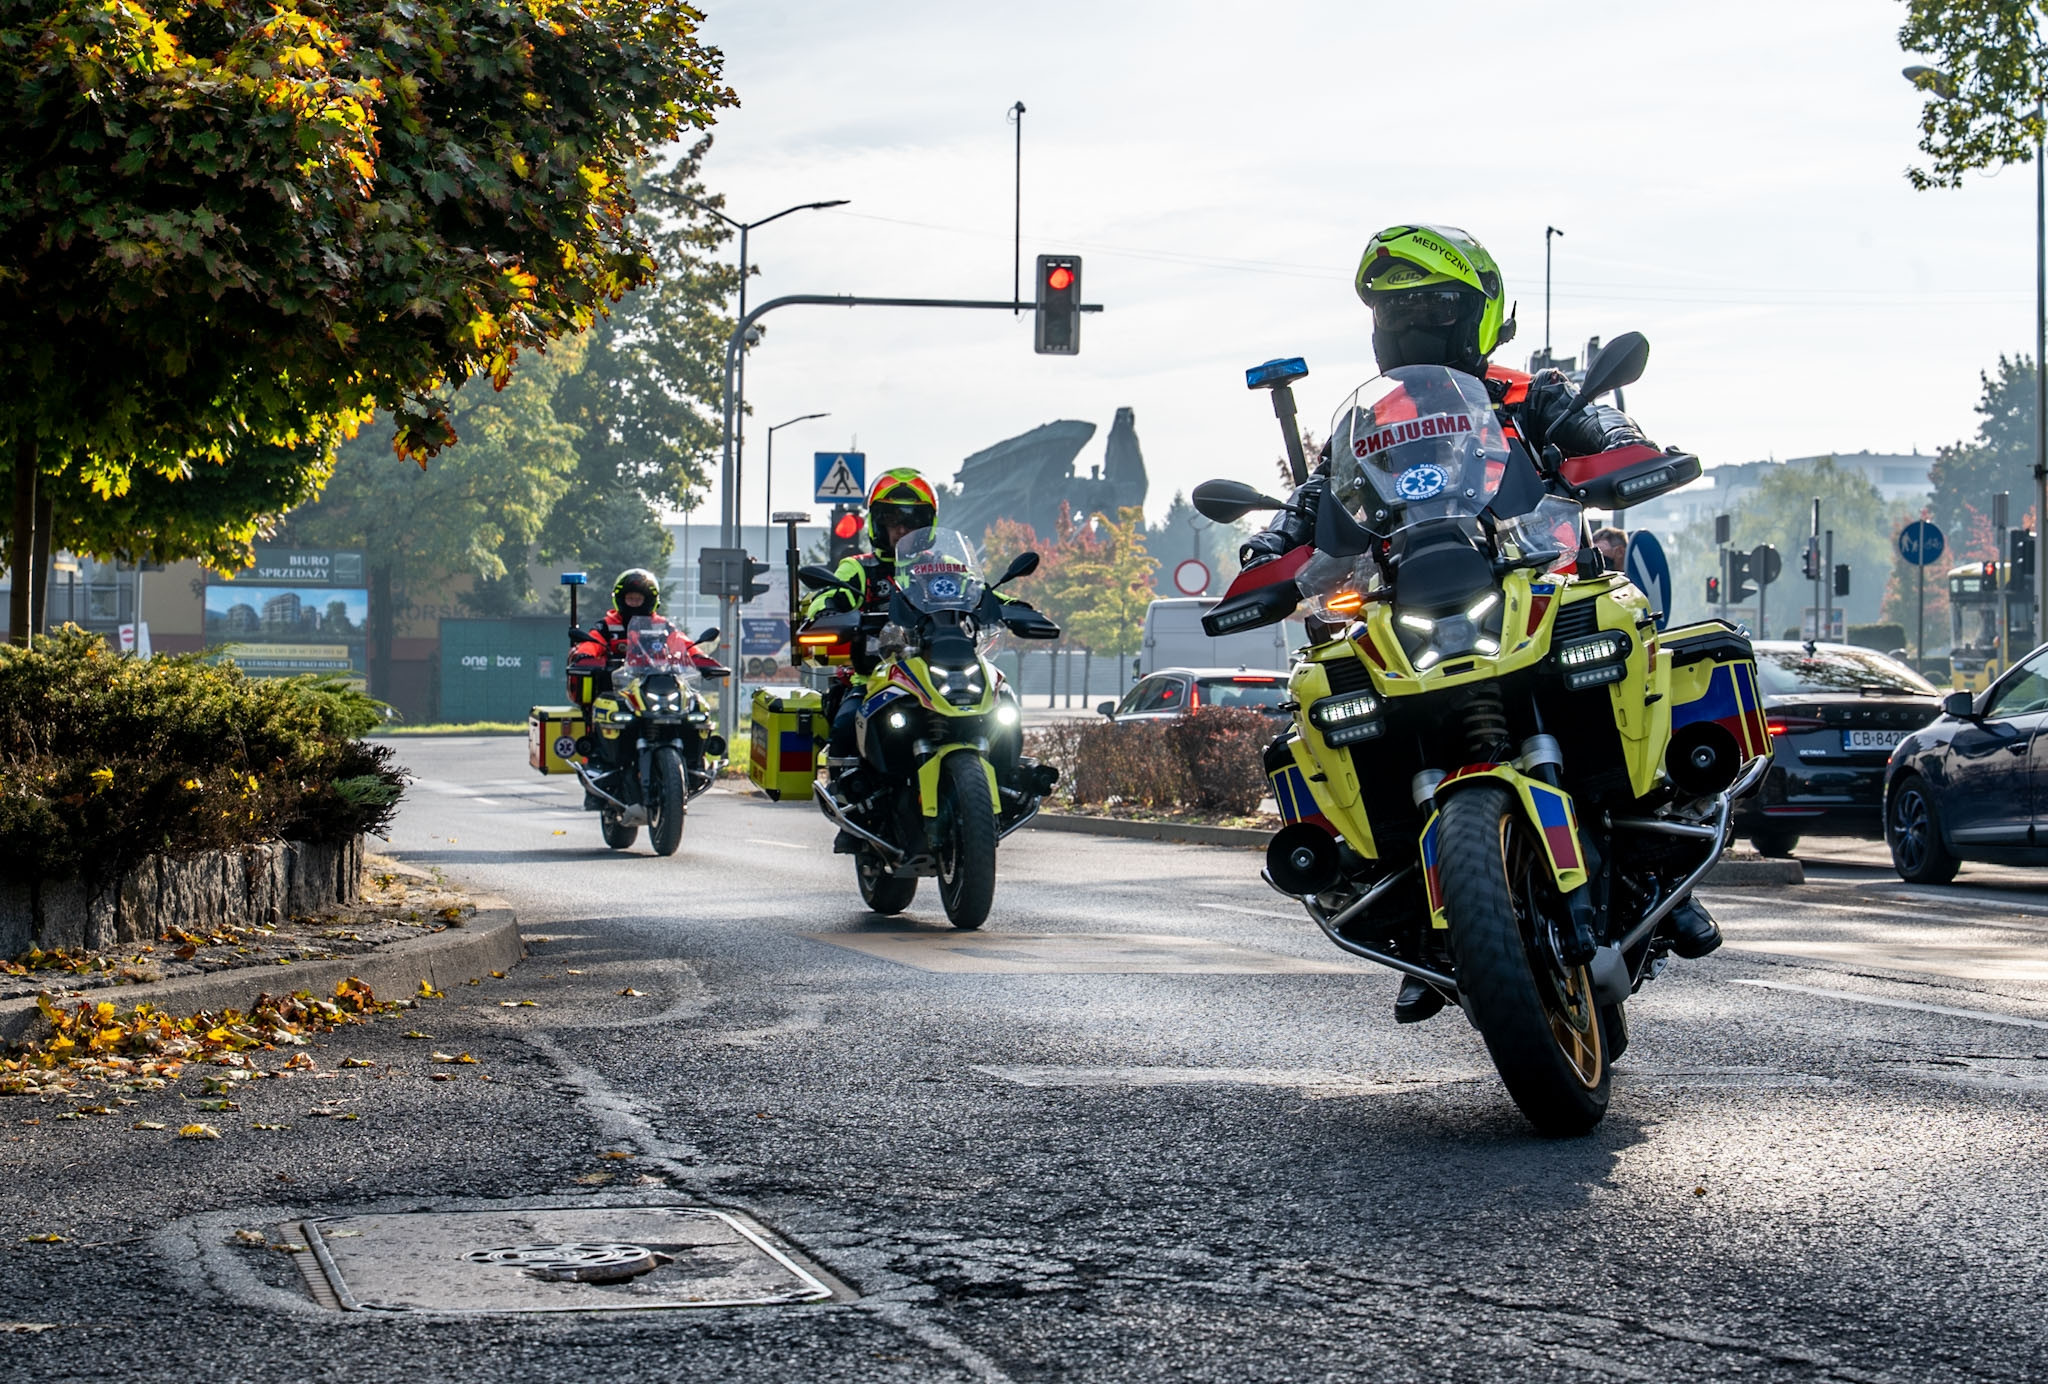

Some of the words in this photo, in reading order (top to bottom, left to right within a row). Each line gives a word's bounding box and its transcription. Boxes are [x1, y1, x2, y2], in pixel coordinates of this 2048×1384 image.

[1412, 234, 1470, 276] MEDYCZNY
[289, 555, 330, 566] BIURO
[258, 567, 330, 579] SPRZEDAŻY
[461, 655, 488, 667] one
[496, 654, 522, 667] box
[1852, 731, 1871, 746] CB
